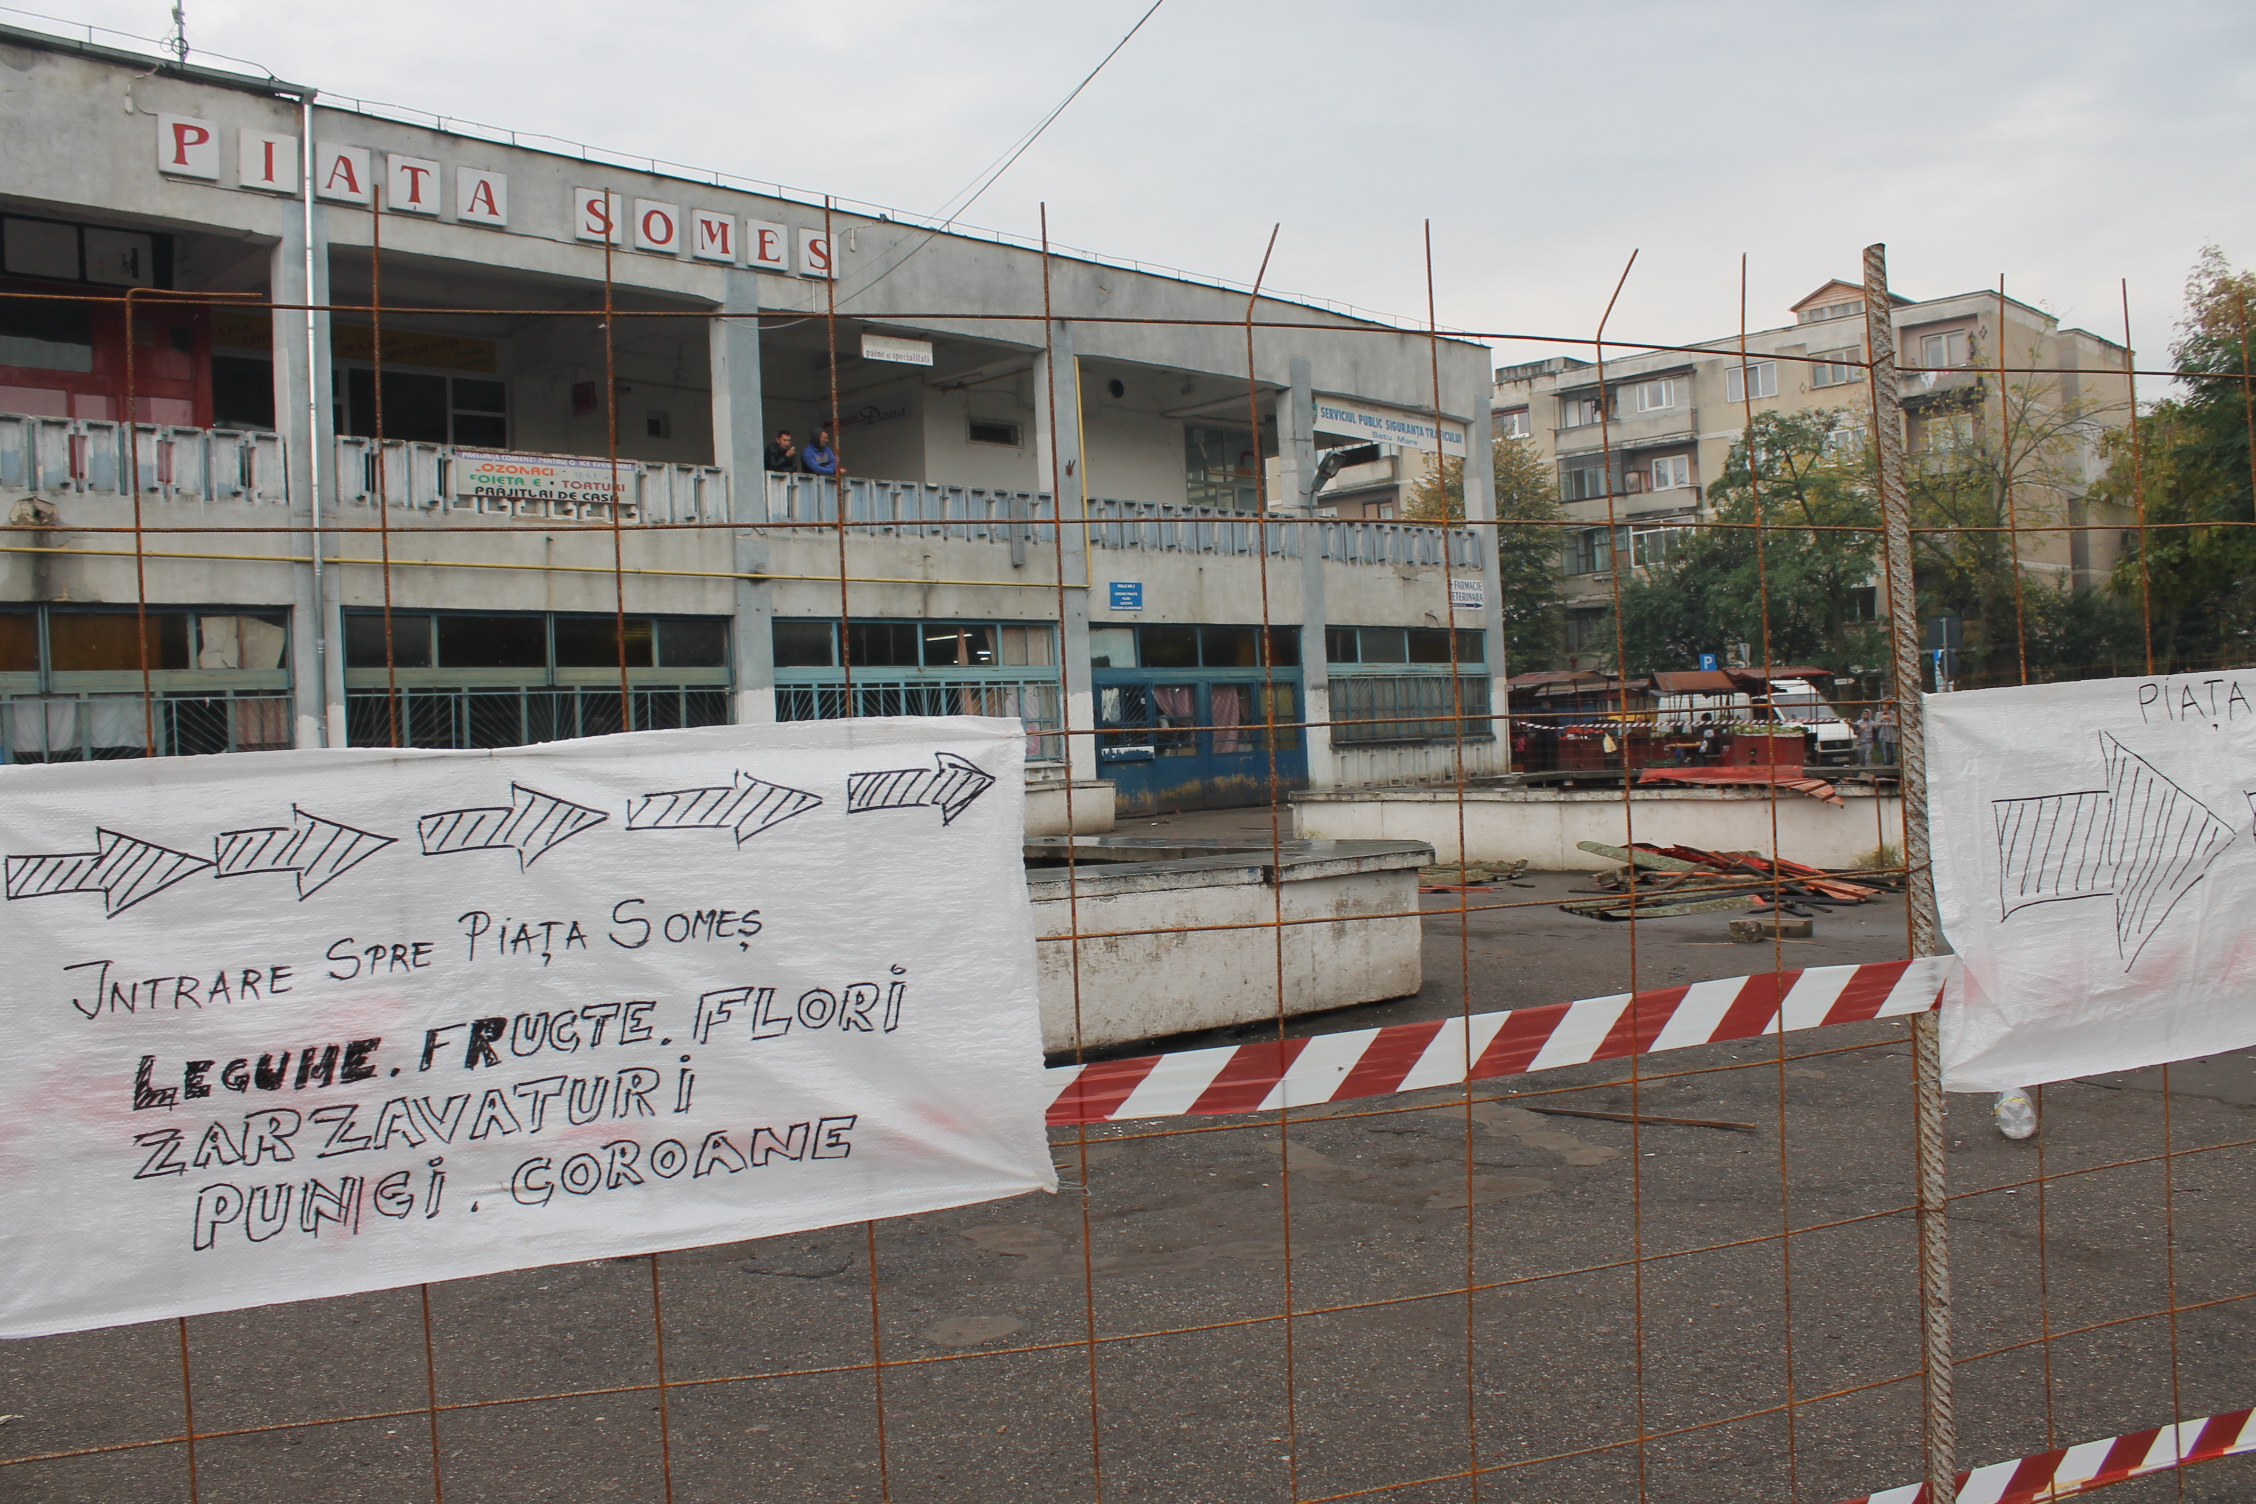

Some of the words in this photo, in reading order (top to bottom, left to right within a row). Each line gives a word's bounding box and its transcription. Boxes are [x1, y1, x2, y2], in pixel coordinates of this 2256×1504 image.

[1320, 406, 1357, 424] SERVICIUL
[1358, 413, 1383, 429] PUBLIC
[1372, 431, 1393, 441] Satu
[1397, 435, 1418, 446] Mare
[475, 463, 556, 477] OZONACI
[569, 459, 591, 468] OICE
[558, 491, 577, 501] DE
[1454, 580, 1483, 592] FARMACIE
[1451, 591, 1484, 602] ETERINARA
[1704, 656, 1713, 670] P
[325, 937, 434, 981] SPRE
[511, 1115, 858, 1207] COROANE
